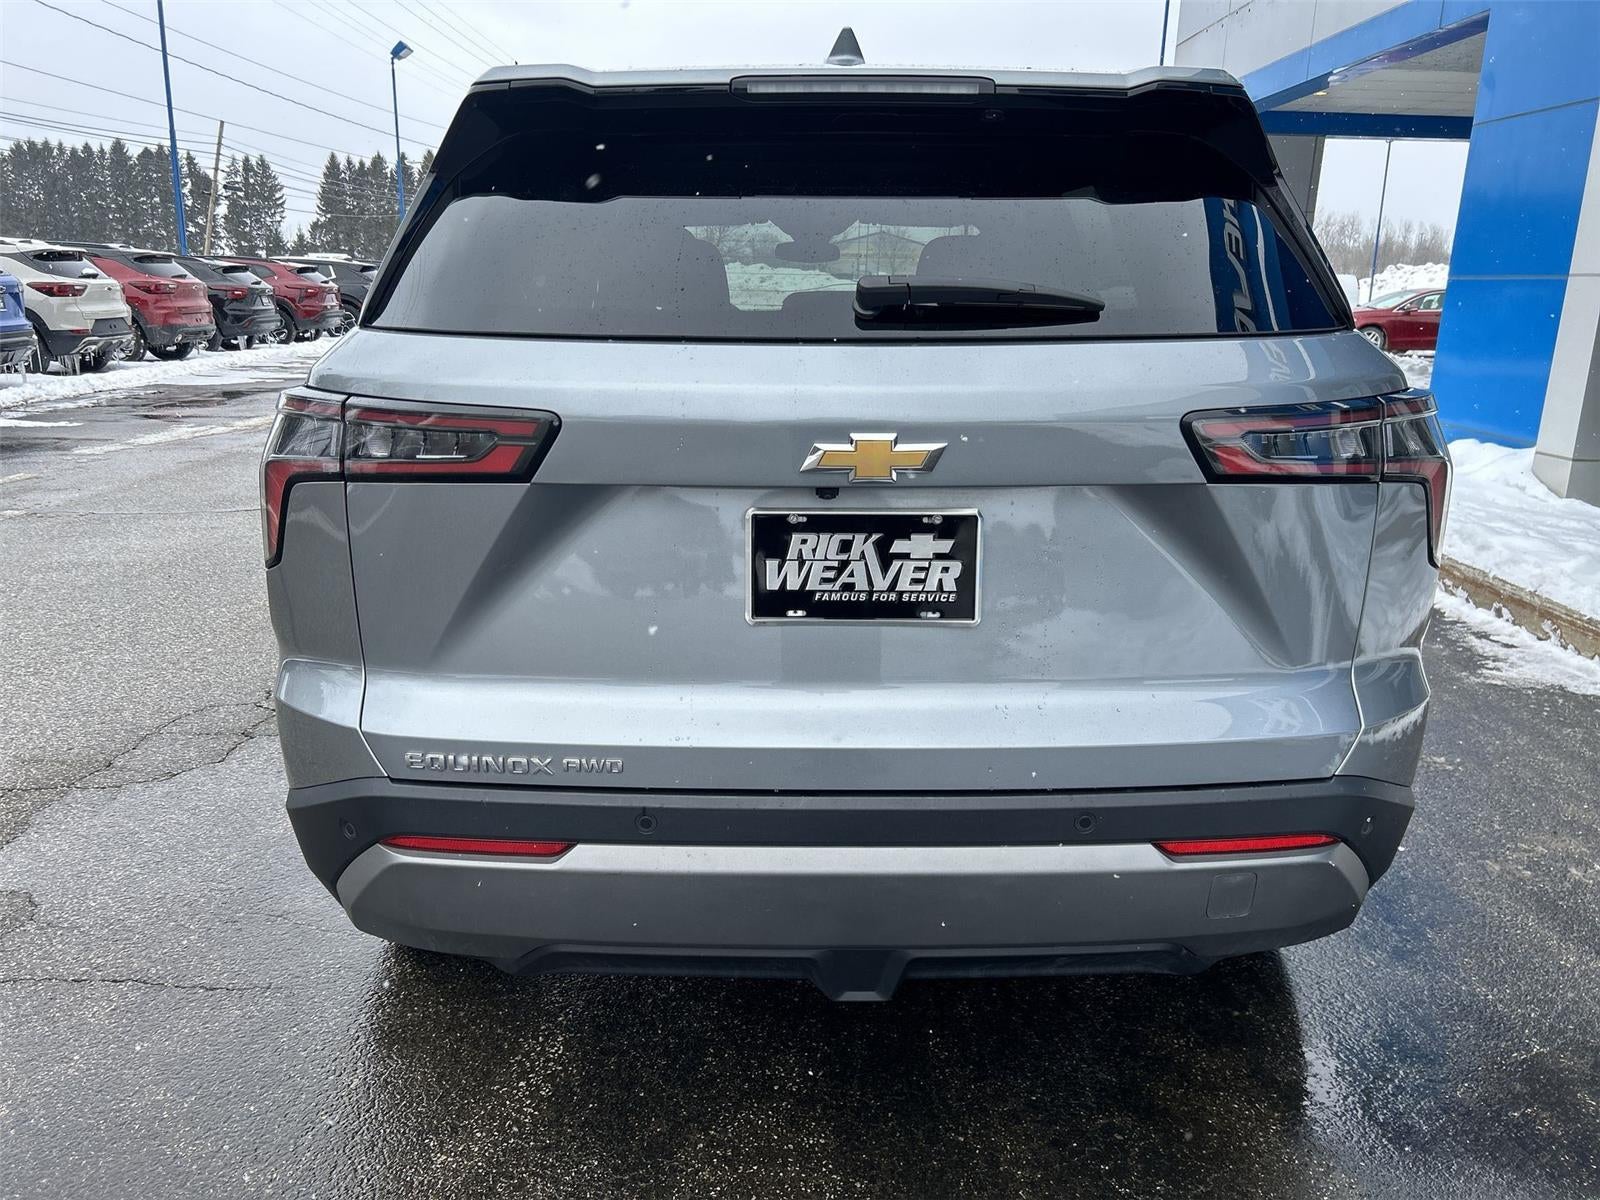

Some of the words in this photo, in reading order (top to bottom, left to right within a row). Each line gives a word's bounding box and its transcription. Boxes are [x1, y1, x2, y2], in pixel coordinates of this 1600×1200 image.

[786, 533, 884, 561] RICK
[765, 560, 963, 591] WEAVER
[815, 592, 866, 601] FAMOUS
[872, 592, 896, 602] FOR
[902, 592, 956, 602] SERVICE
[404, 752, 555, 775] EQUINOX
[562, 758, 624, 774] AWD
